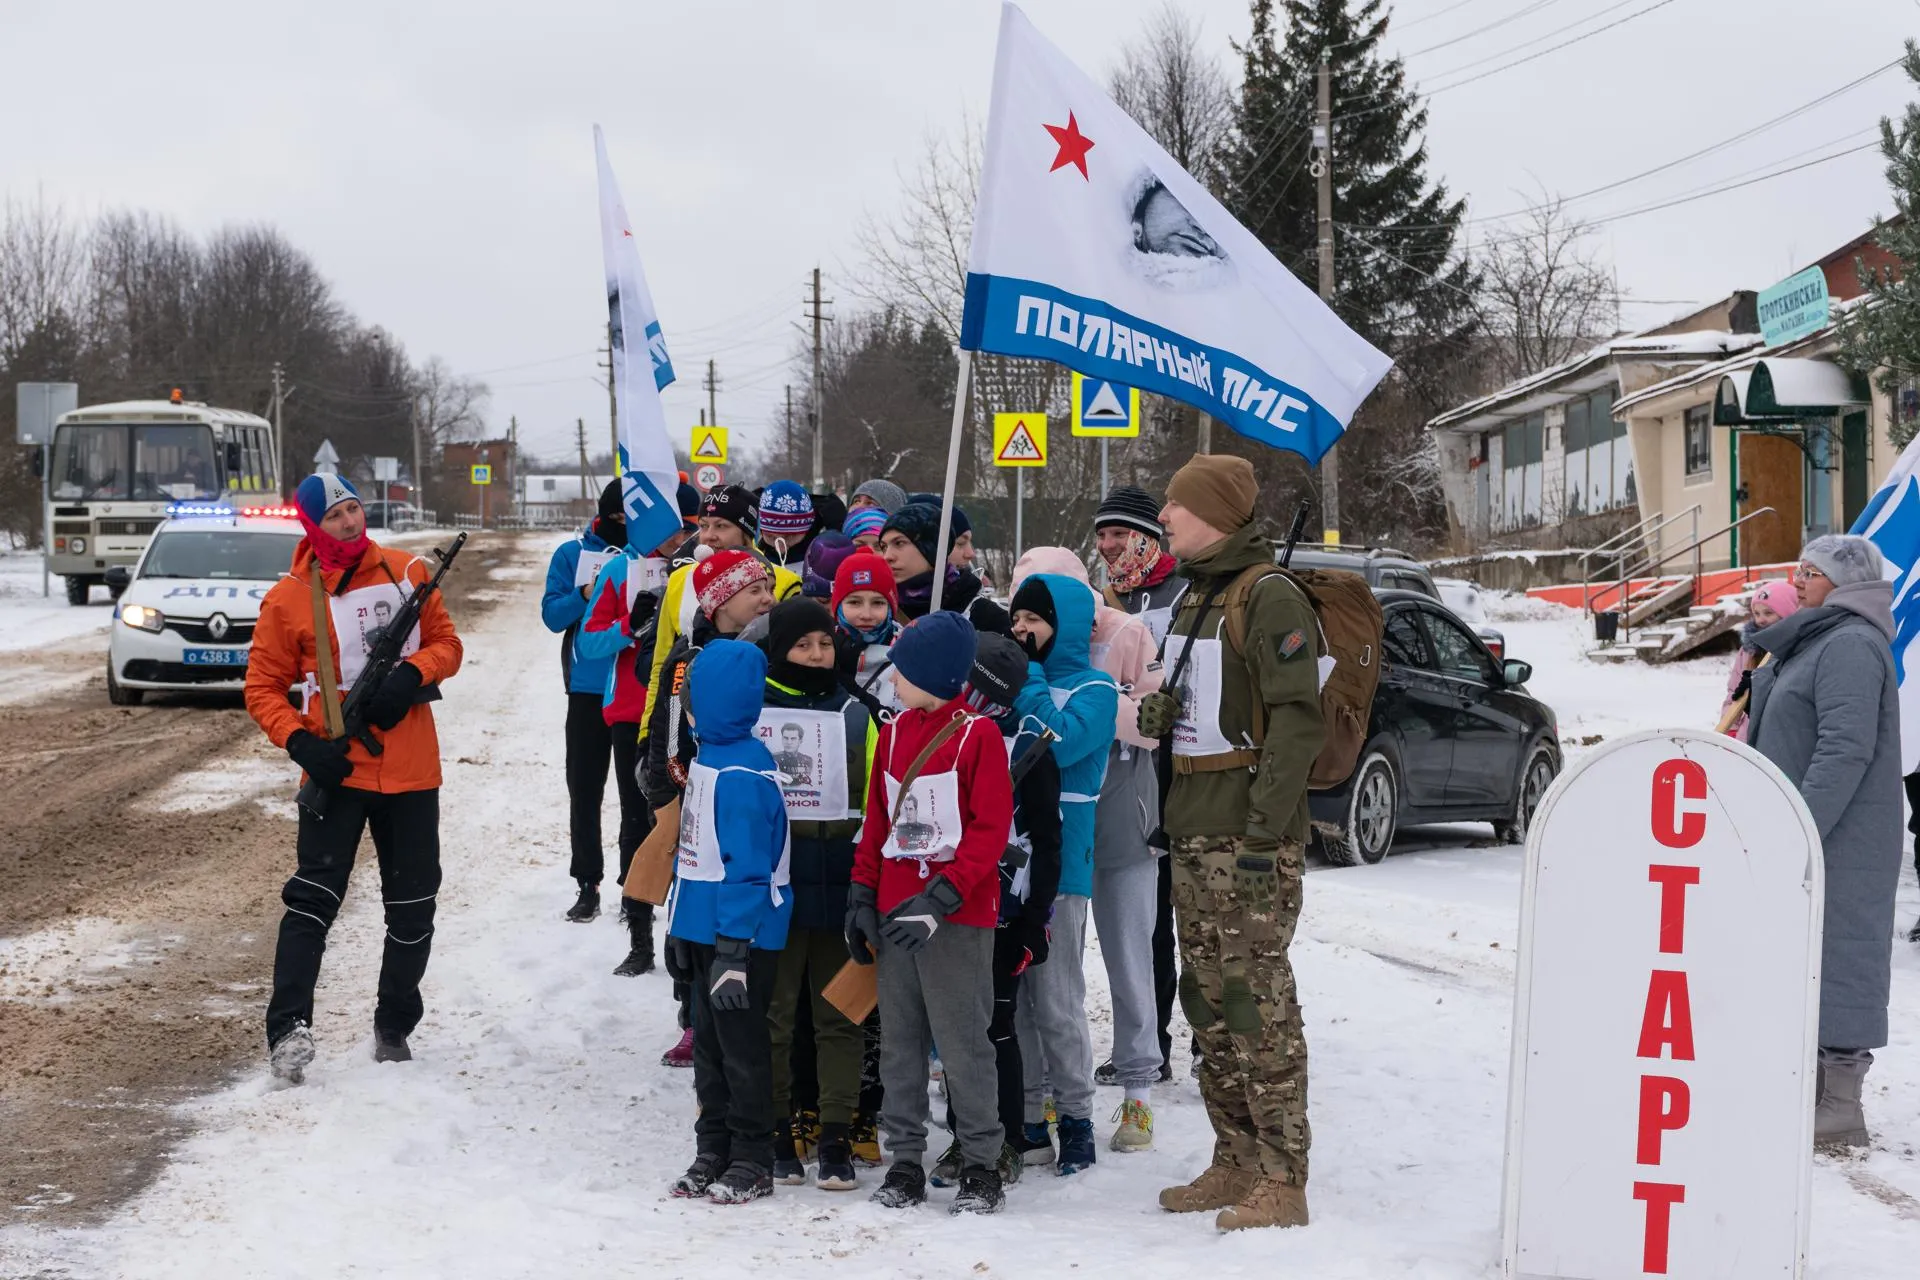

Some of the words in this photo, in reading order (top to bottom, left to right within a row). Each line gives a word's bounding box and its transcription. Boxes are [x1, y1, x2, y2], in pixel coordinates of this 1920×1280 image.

[1015, 295, 1215, 397] ПОЛЯРНЫЙ
[702, 471, 717, 482] 20
[357, 607, 368, 618] 21
[201, 651, 231, 662] 4383
[973, 658, 1009, 690] NORDSKI
[760, 726, 773, 738] 21
[1632, 758, 1707, 1275] СТАРТ
